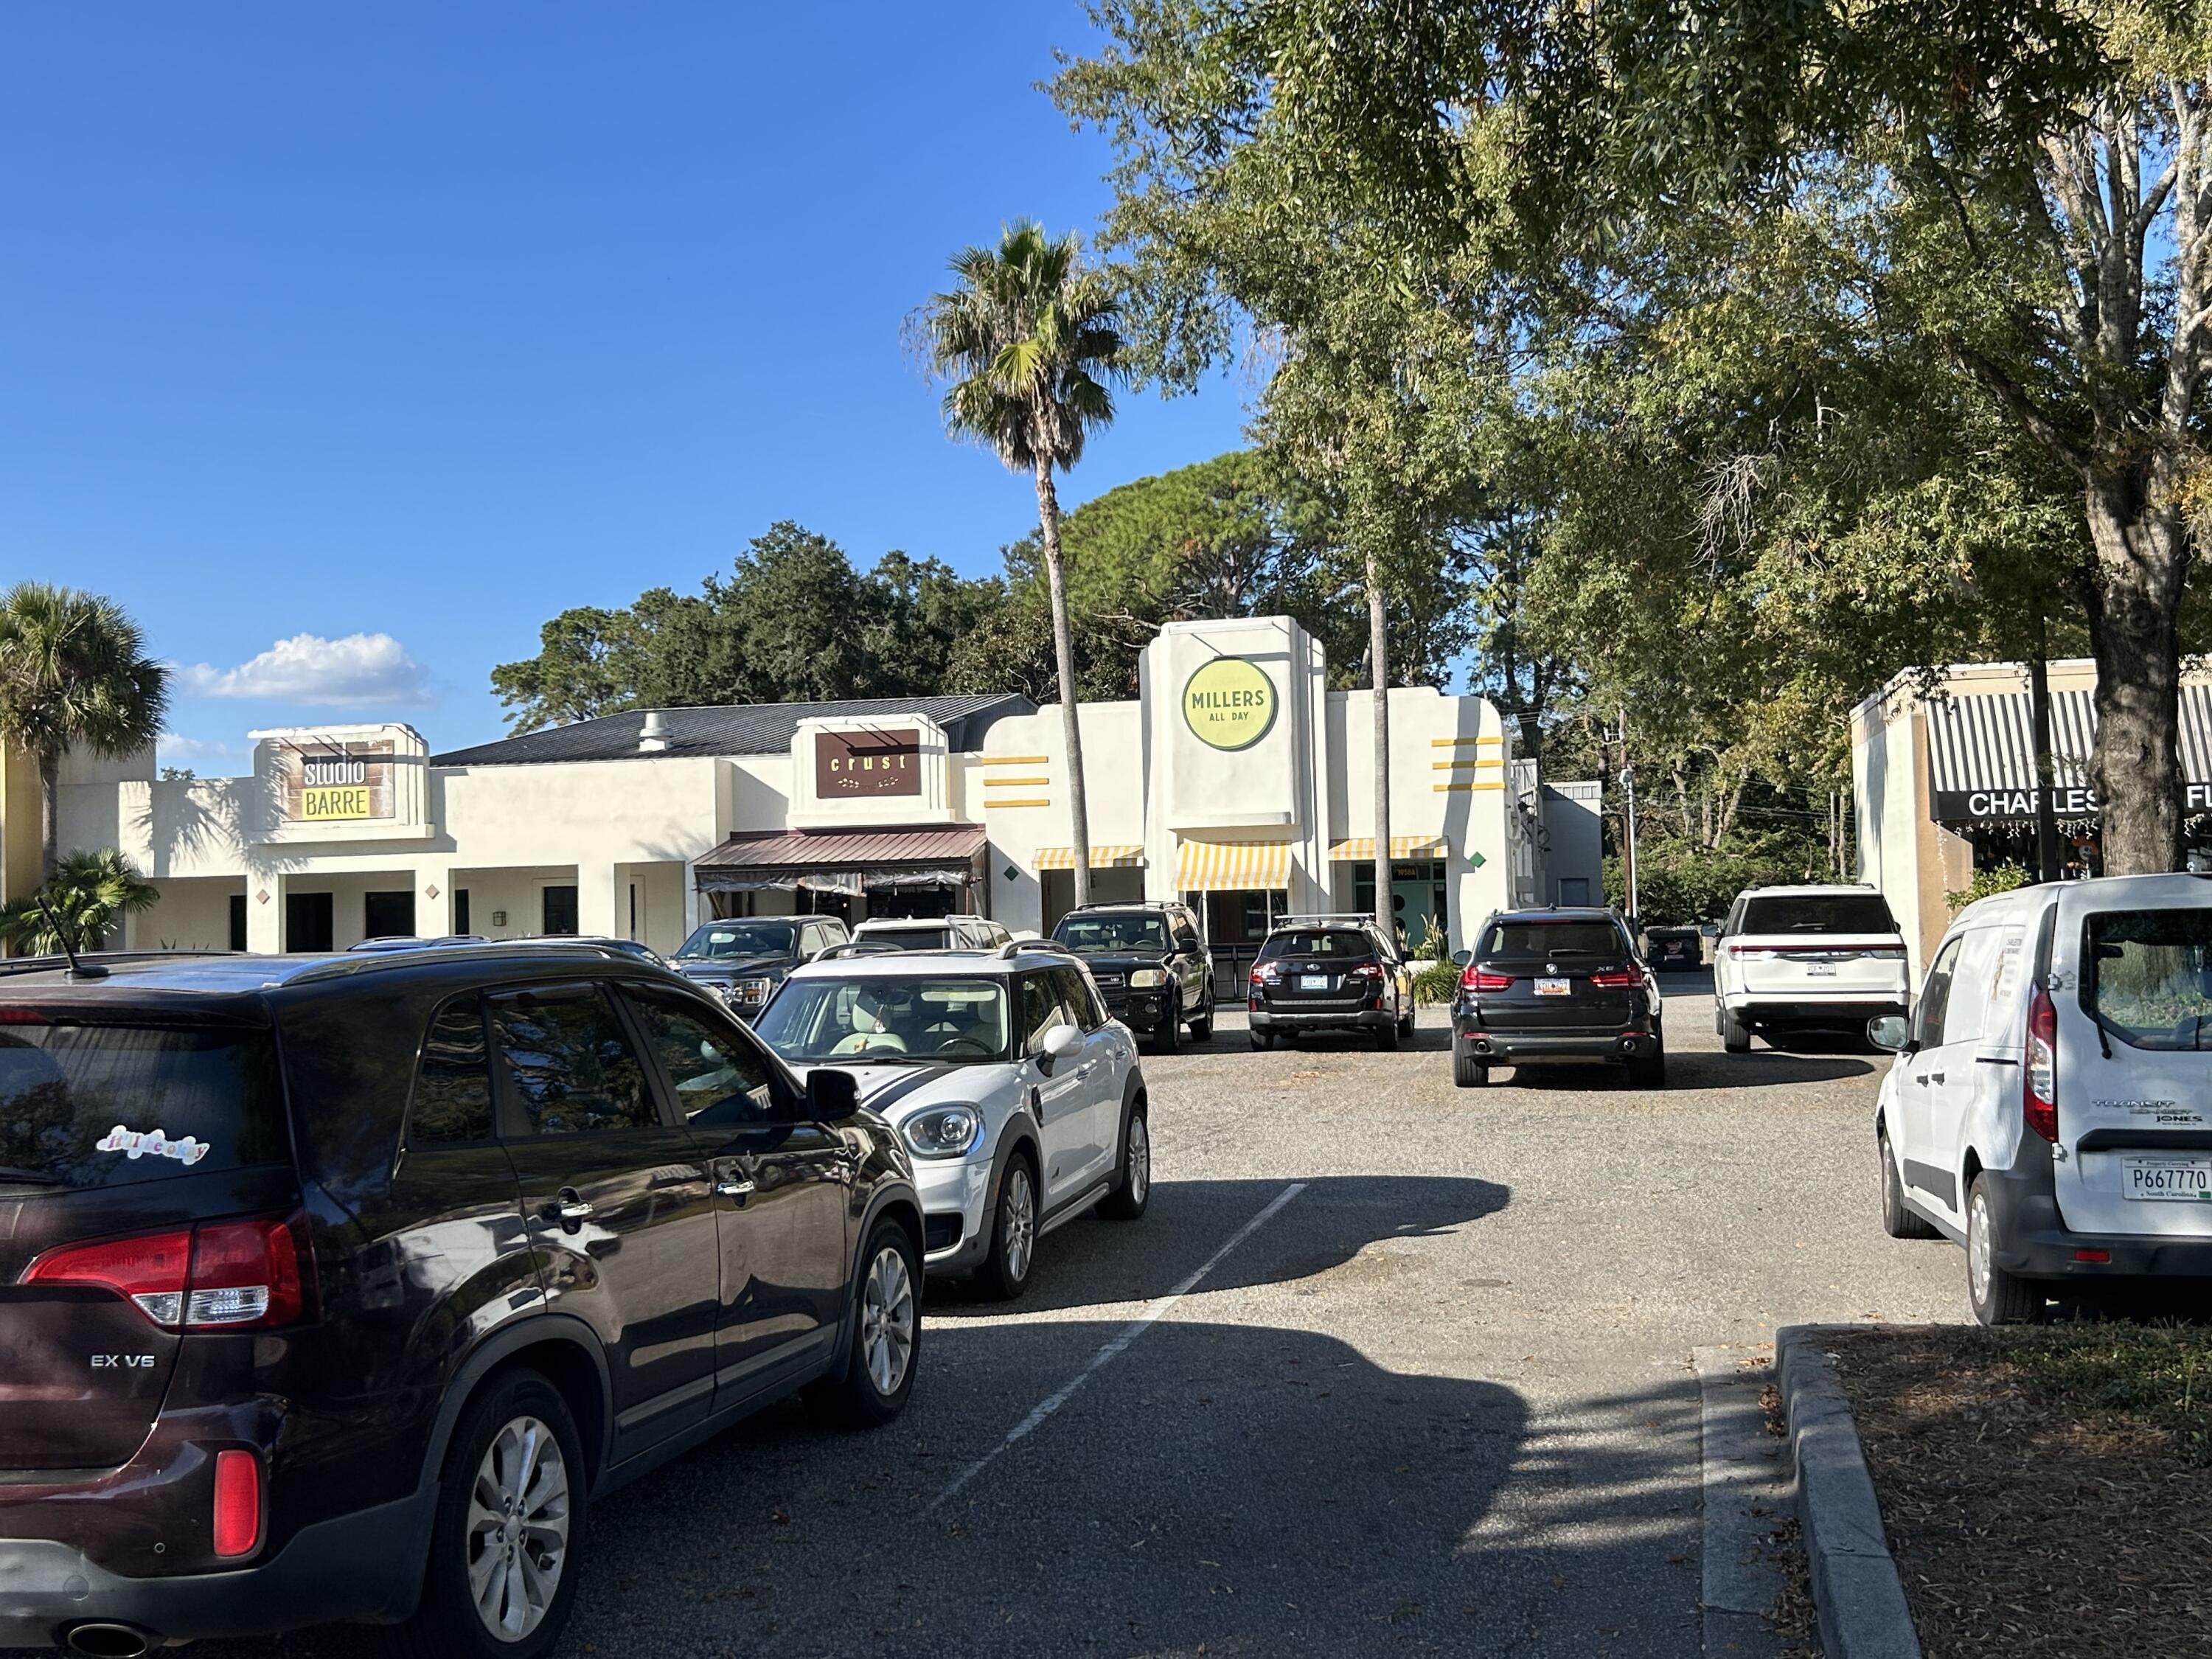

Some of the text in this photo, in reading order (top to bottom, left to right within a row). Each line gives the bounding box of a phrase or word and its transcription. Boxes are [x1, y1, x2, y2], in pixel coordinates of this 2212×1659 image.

[1192, 689, 1265, 709] MILLERS
[1209, 712, 1249, 722] ALL DAY
[305, 754, 366, 786] studio
[831, 754, 906, 772] crust
[306, 790, 366, 815] BARRE
[2091, 1099, 2175, 1107] TRANSIT
[167, 1142, 207, 1160] okay
[2133, 1169, 2206, 1189] P667770
[91, 1354, 155, 1367] EX V6
